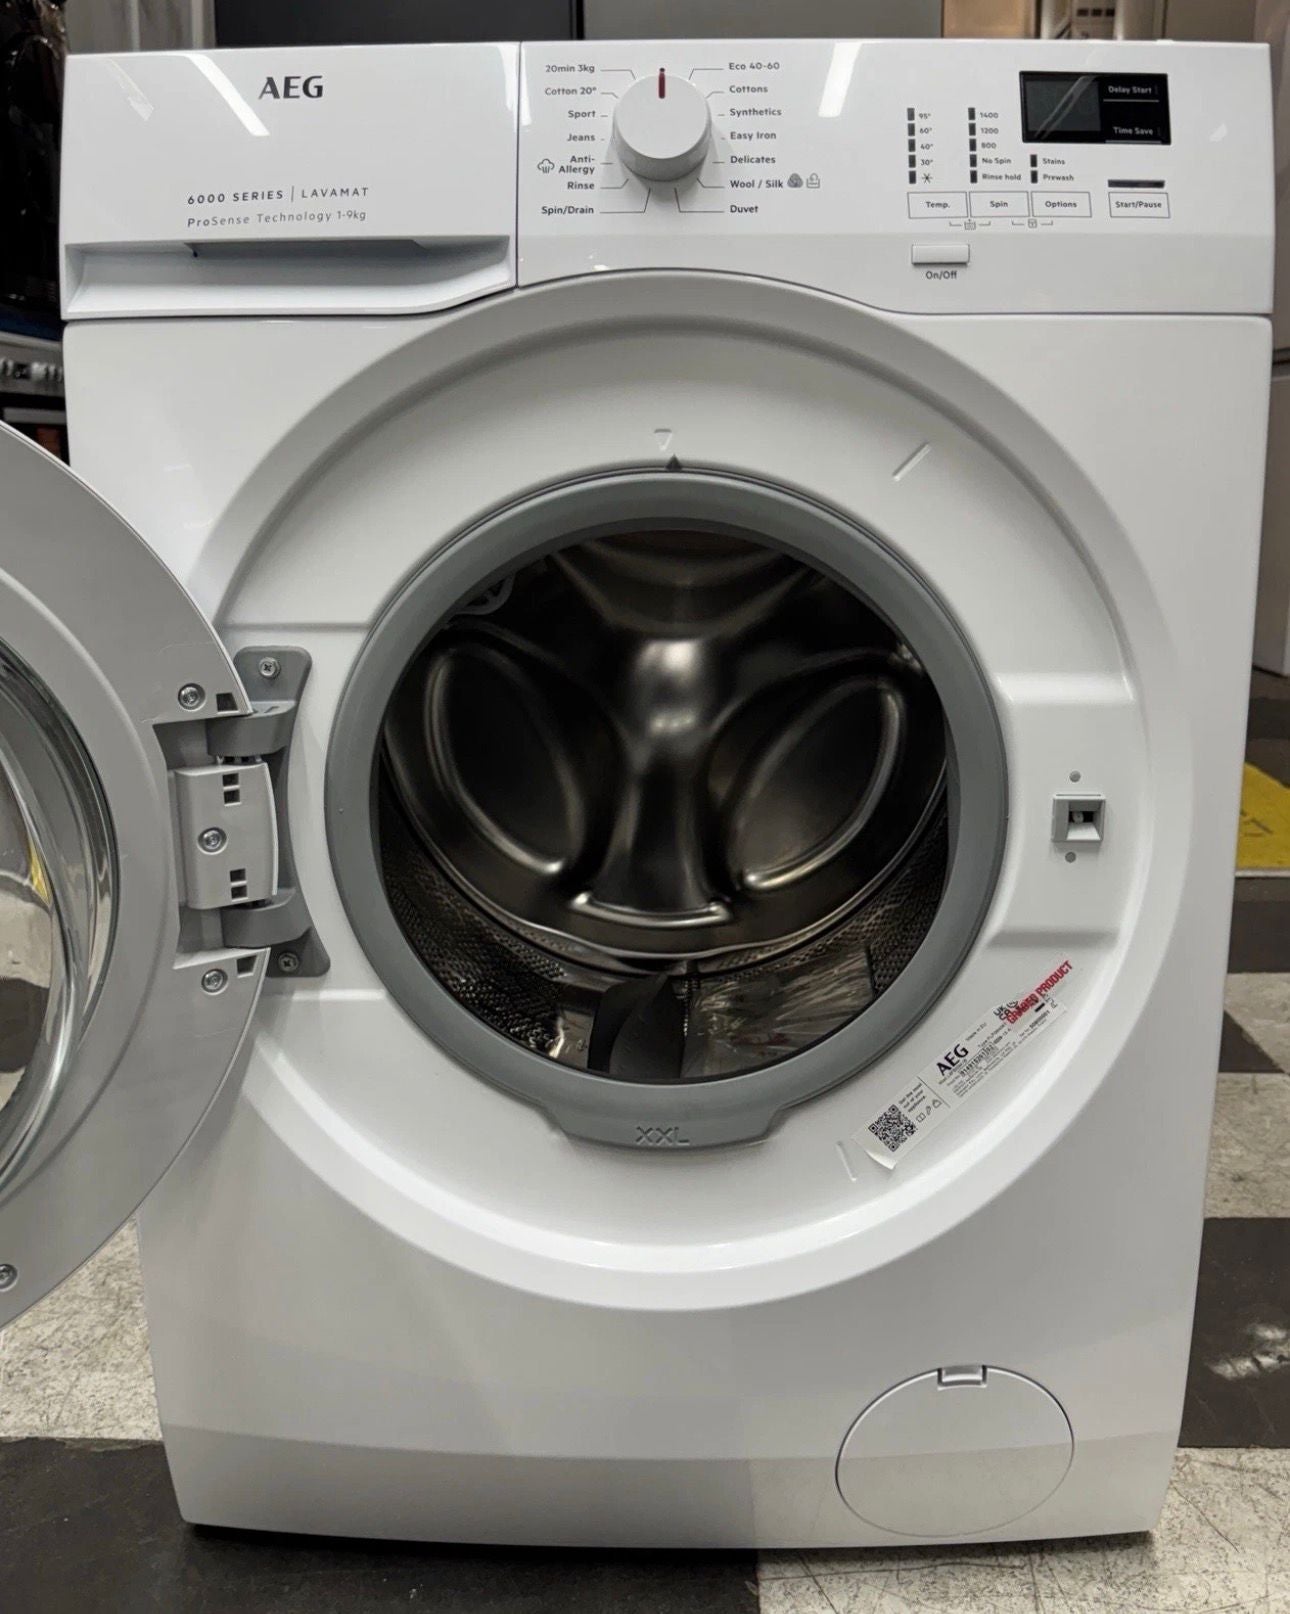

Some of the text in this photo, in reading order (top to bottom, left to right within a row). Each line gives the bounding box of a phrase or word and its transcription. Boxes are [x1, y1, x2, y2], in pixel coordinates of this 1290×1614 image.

[545, 65, 595, 75] 20min 3kg
[728, 62, 780, 71] Eco 40-60
[258, 75, 324, 100] AEG
[544, 86, 597, 96] Cotton 20°
[729, 85, 768, 94] Cottons
[1108, 85, 1152, 94] Delay Start
[567, 110, 596, 119] Sport
[729, 108, 782, 118] Synthetics
[979, 111, 999, 119] 1400
[919, 127, 933, 135] 60°
[980, 127, 999, 135] 1200
[1113, 126, 1154, 135] Time Save
[566, 133, 596, 142] Jeans
[730, 131, 777, 141] Easy Iron
[920, 142, 934, 151] 40°
[980, 142, 997, 150] 800
[570, 155, 595, 164] Anti-
[730, 155, 776, 165] Delicates
[920, 158, 934, 167] 30°
[981, 156, 1012, 165] No Spin
[1042, 157, 1066, 166] Stains
[558, 165, 595, 175] Allergy
[981, 172, 1022, 181] Rinse hold
[1042, 173, 1075, 182] Prewash
[567, 180, 595, 190] Rinse
[730, 180, 755, 189] Wool
[765, 179, 784, 189] Silk
[187, 186, 369, 206] 6000 SERIES LAVAMAT
[730, 204, 759, 214] Duvet
[926, 201, 950, 209] Temp.
[990, 200, 1009, 209] Spin
[1044, 200, 1078, 209] Options
[1115, 200, 1162, 209] Start/Pause
[541, 205, 595, 215] Spin/Drain
[187, 209, 367, 228] ProSense Technology 1-9kg
[925, 270, 958, 281] On/Off
[1006, 992, 1040, 1025] GRADED
[1035, 959, 1073, 998] PRODUCT
[993, 1003, 1006, 1017] UK
[935, 1042, 969, 1076] AEG
[635, 1126, 690, 1146] XXL
